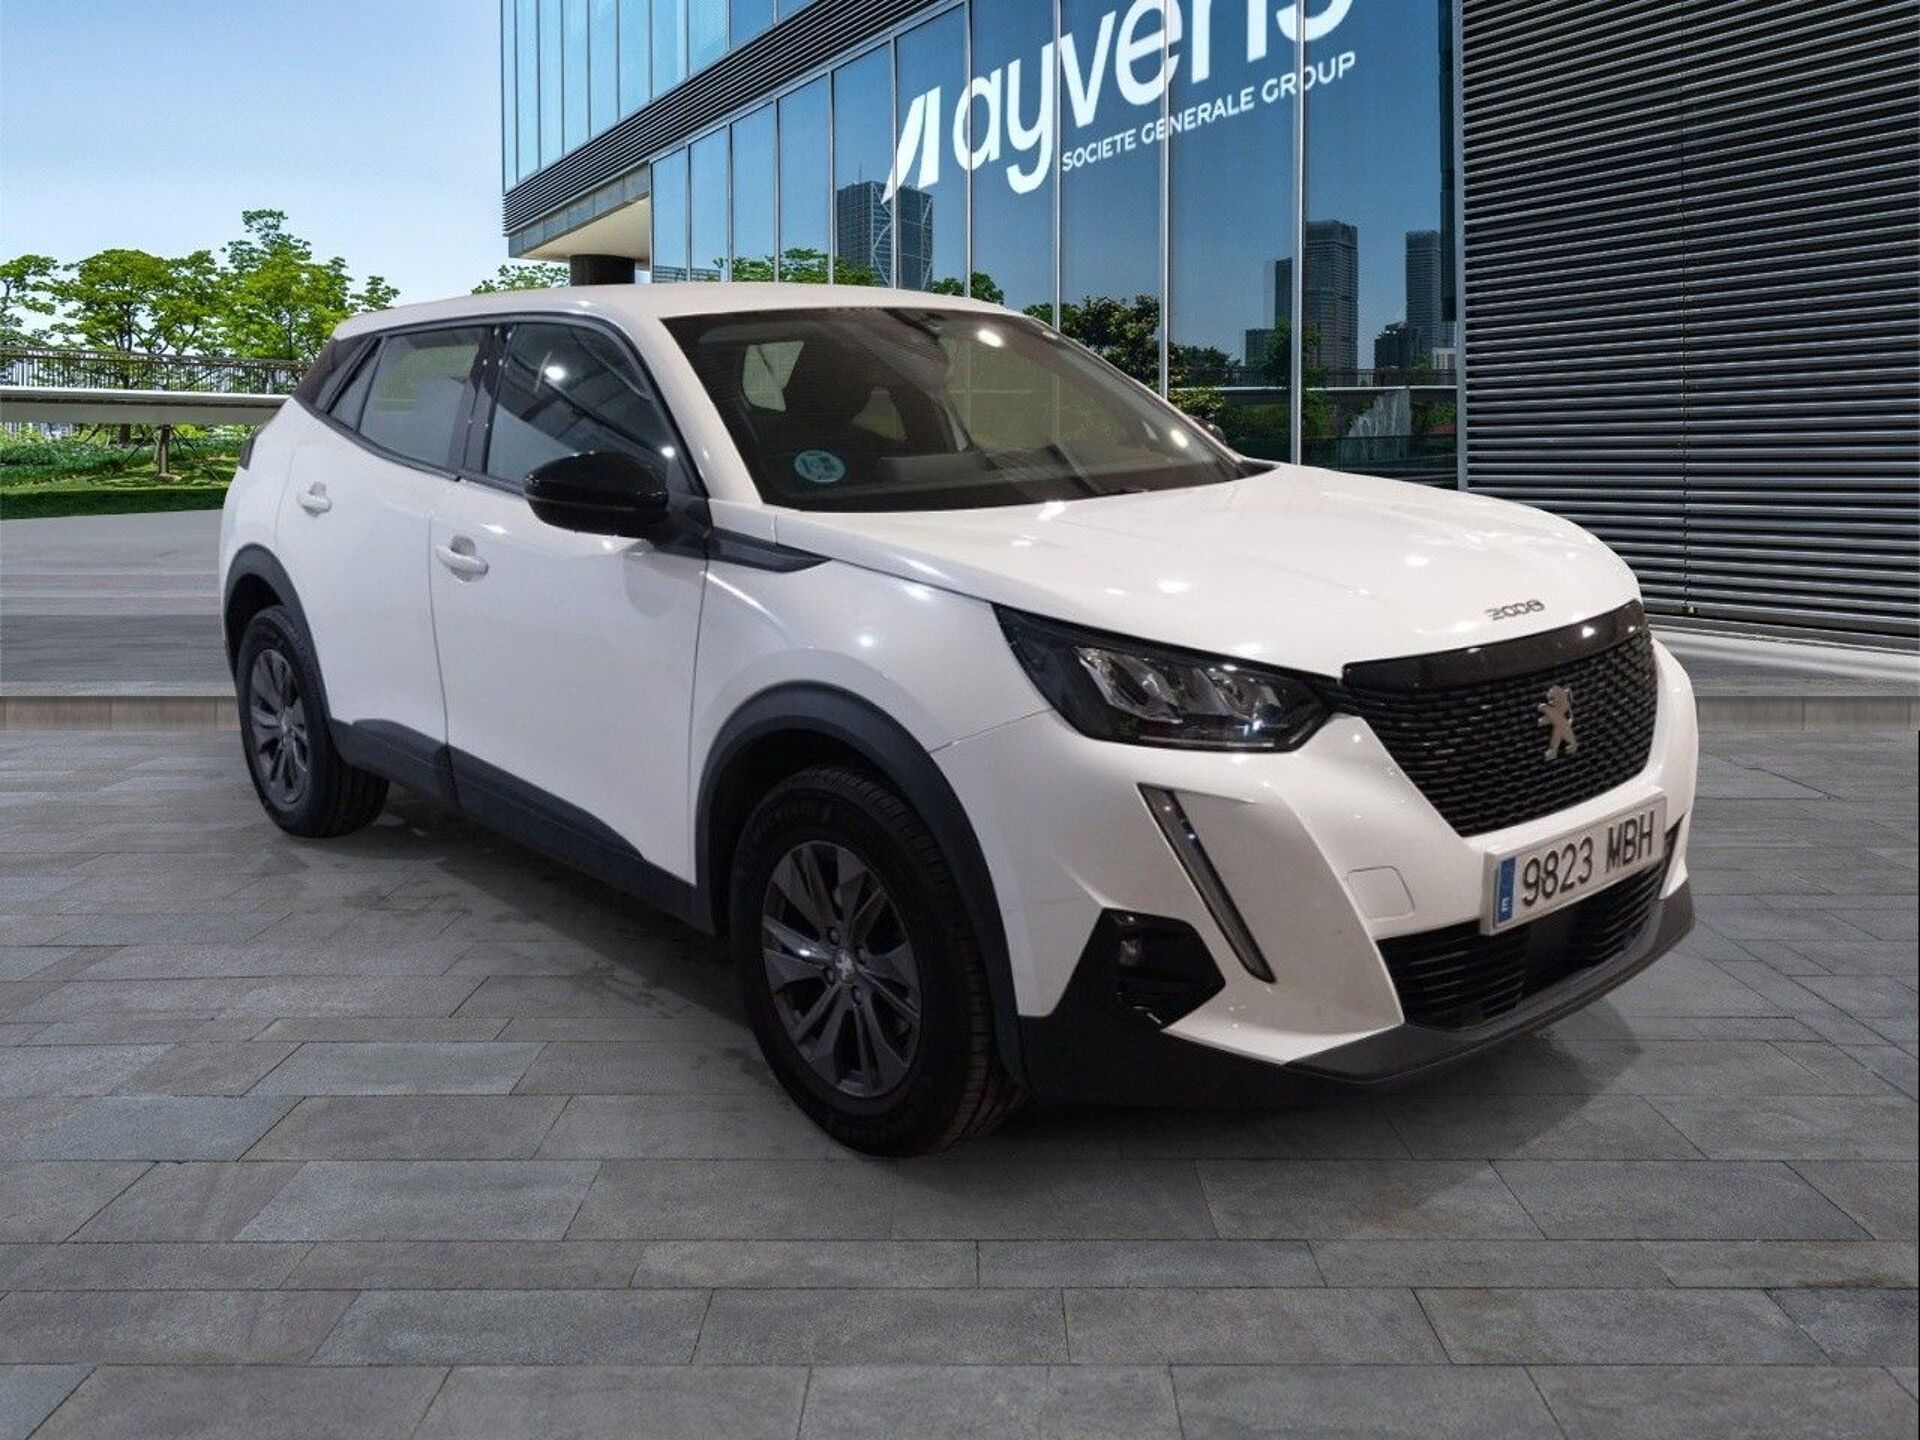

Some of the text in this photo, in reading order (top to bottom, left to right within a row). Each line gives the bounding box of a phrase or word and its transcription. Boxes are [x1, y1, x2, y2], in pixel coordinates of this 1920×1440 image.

[1062, 51, 1356, 172] SOCIETE GENERALE GROUP
[1484, 599, 1545, 621] 2008
[1522, 810, 1655, 907] 9823 MBH
